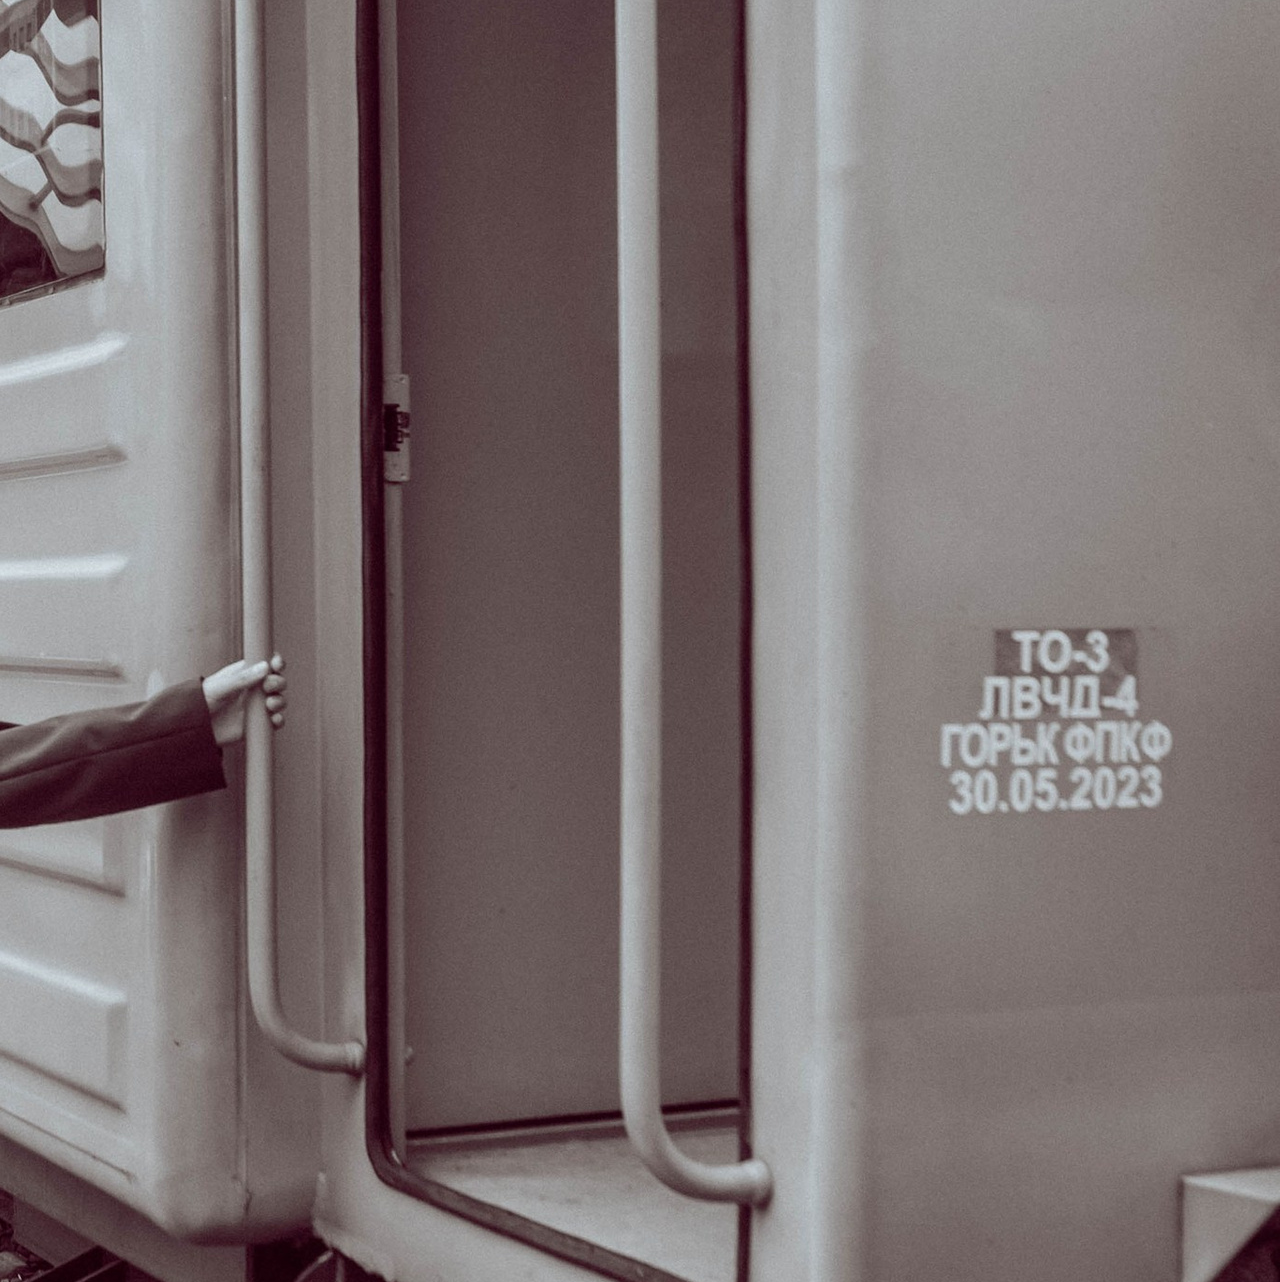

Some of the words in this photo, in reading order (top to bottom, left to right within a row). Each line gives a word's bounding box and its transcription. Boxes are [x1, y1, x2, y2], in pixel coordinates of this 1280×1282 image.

[1011, 630, 1110, 673] ТО-3
[978, 674, 1139, 720] ЛВЧД-4
[940, 722, 1060, 767] ГОРЬК
[1064, 719, 1173, 764] ФПКФ
[949, 765, 1163, 815] 30.05.2023
